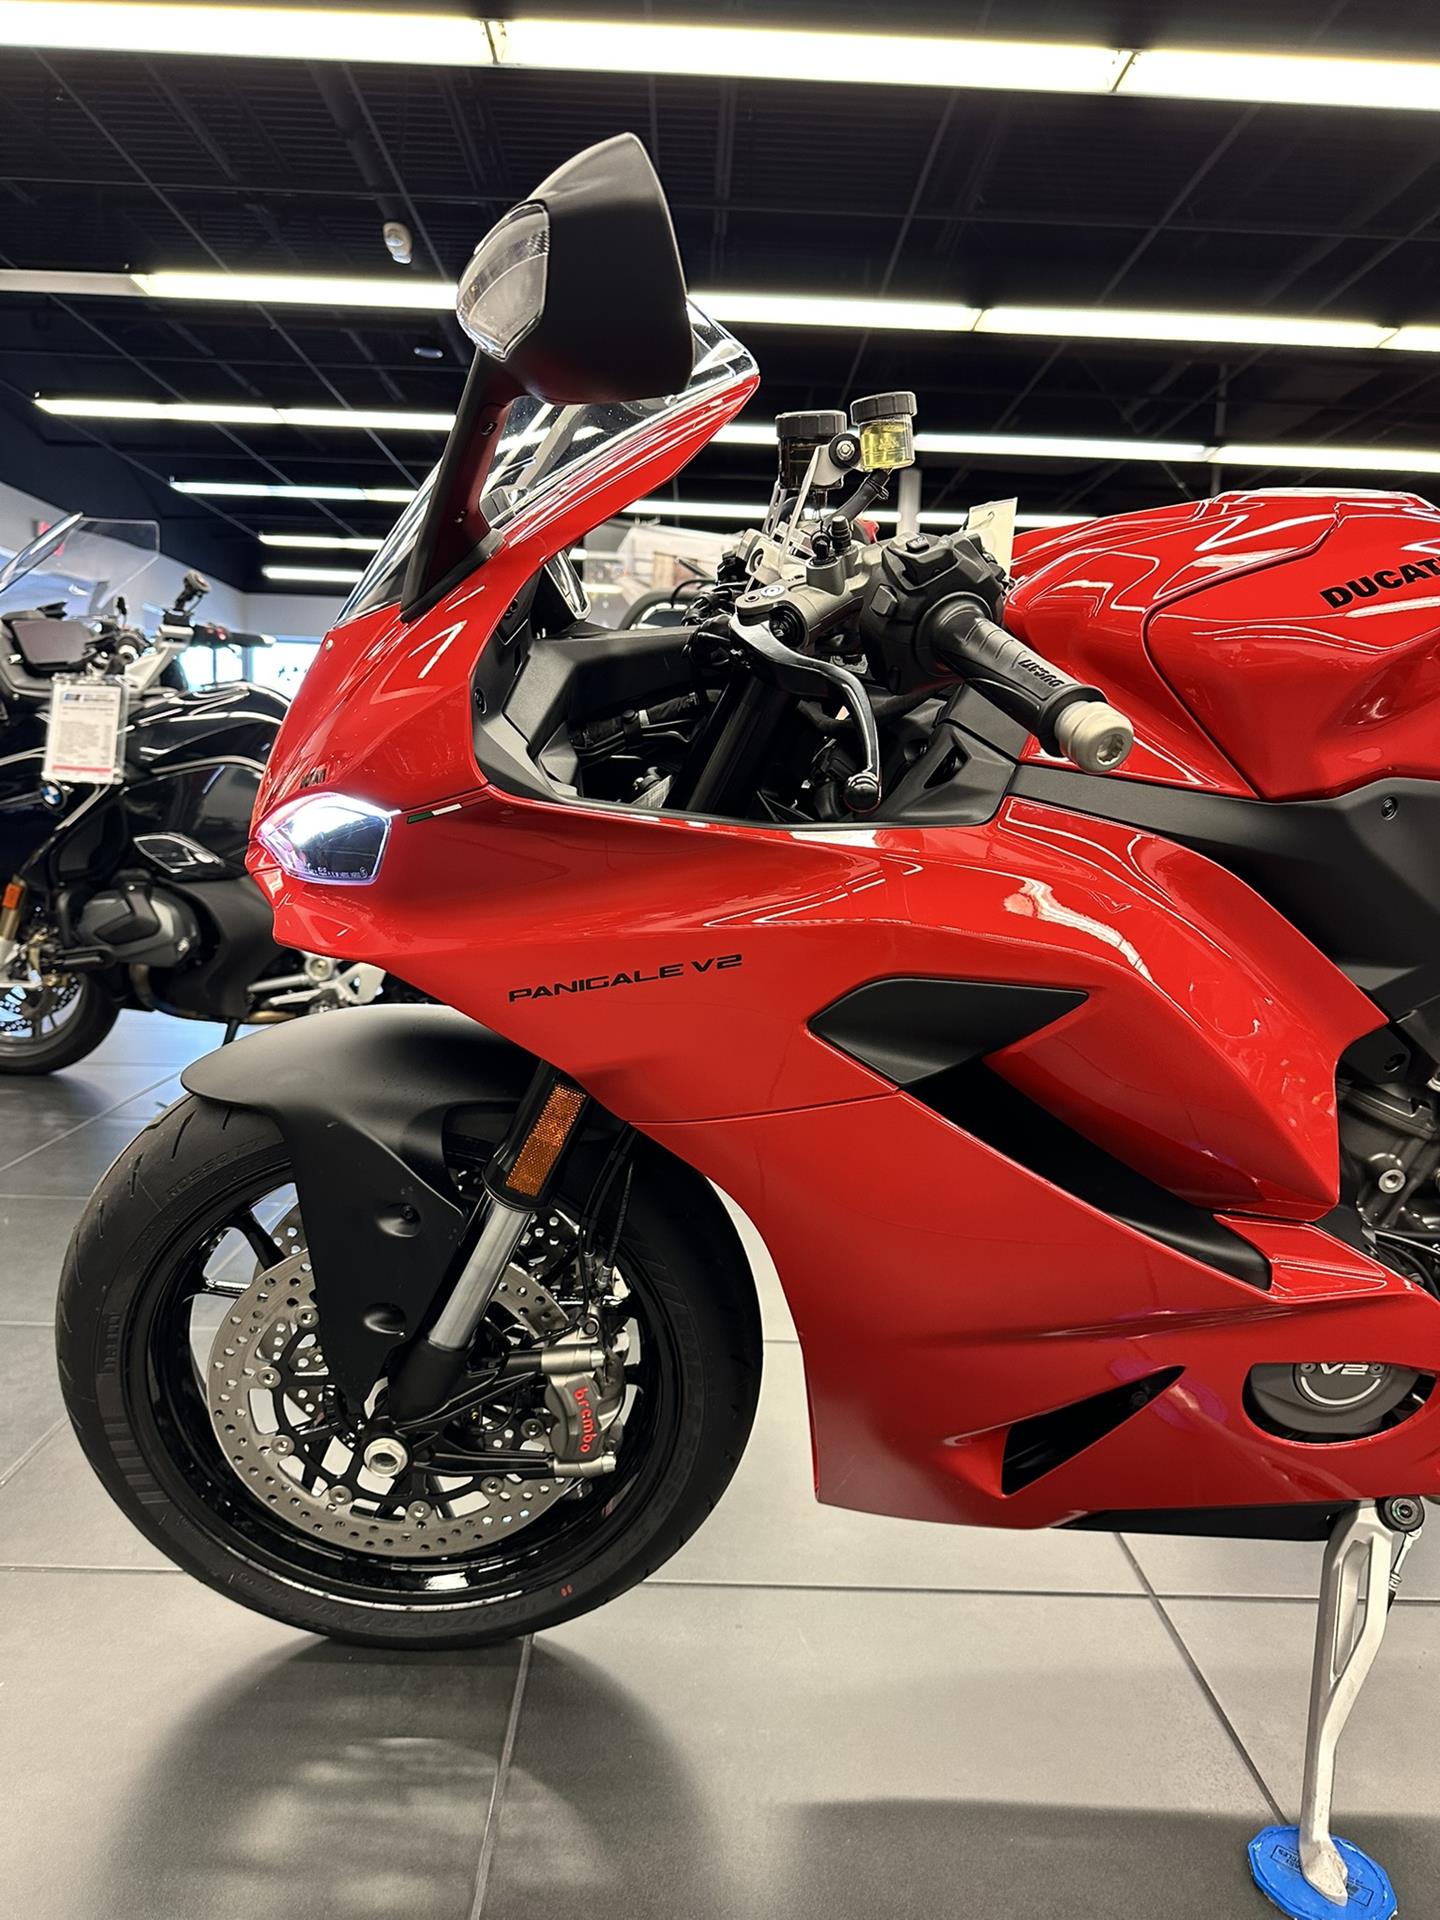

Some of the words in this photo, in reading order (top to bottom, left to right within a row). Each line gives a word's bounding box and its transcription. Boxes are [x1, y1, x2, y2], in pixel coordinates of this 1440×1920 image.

[1320, 556, 1440, 609] DUCAT
[508, 963, 684, 1003] PANIGALE
[691, 954, 743, 973] V2
[1319, 1362, 1370, 1376] V2
[574, 1387, 598, 1453] brembo
